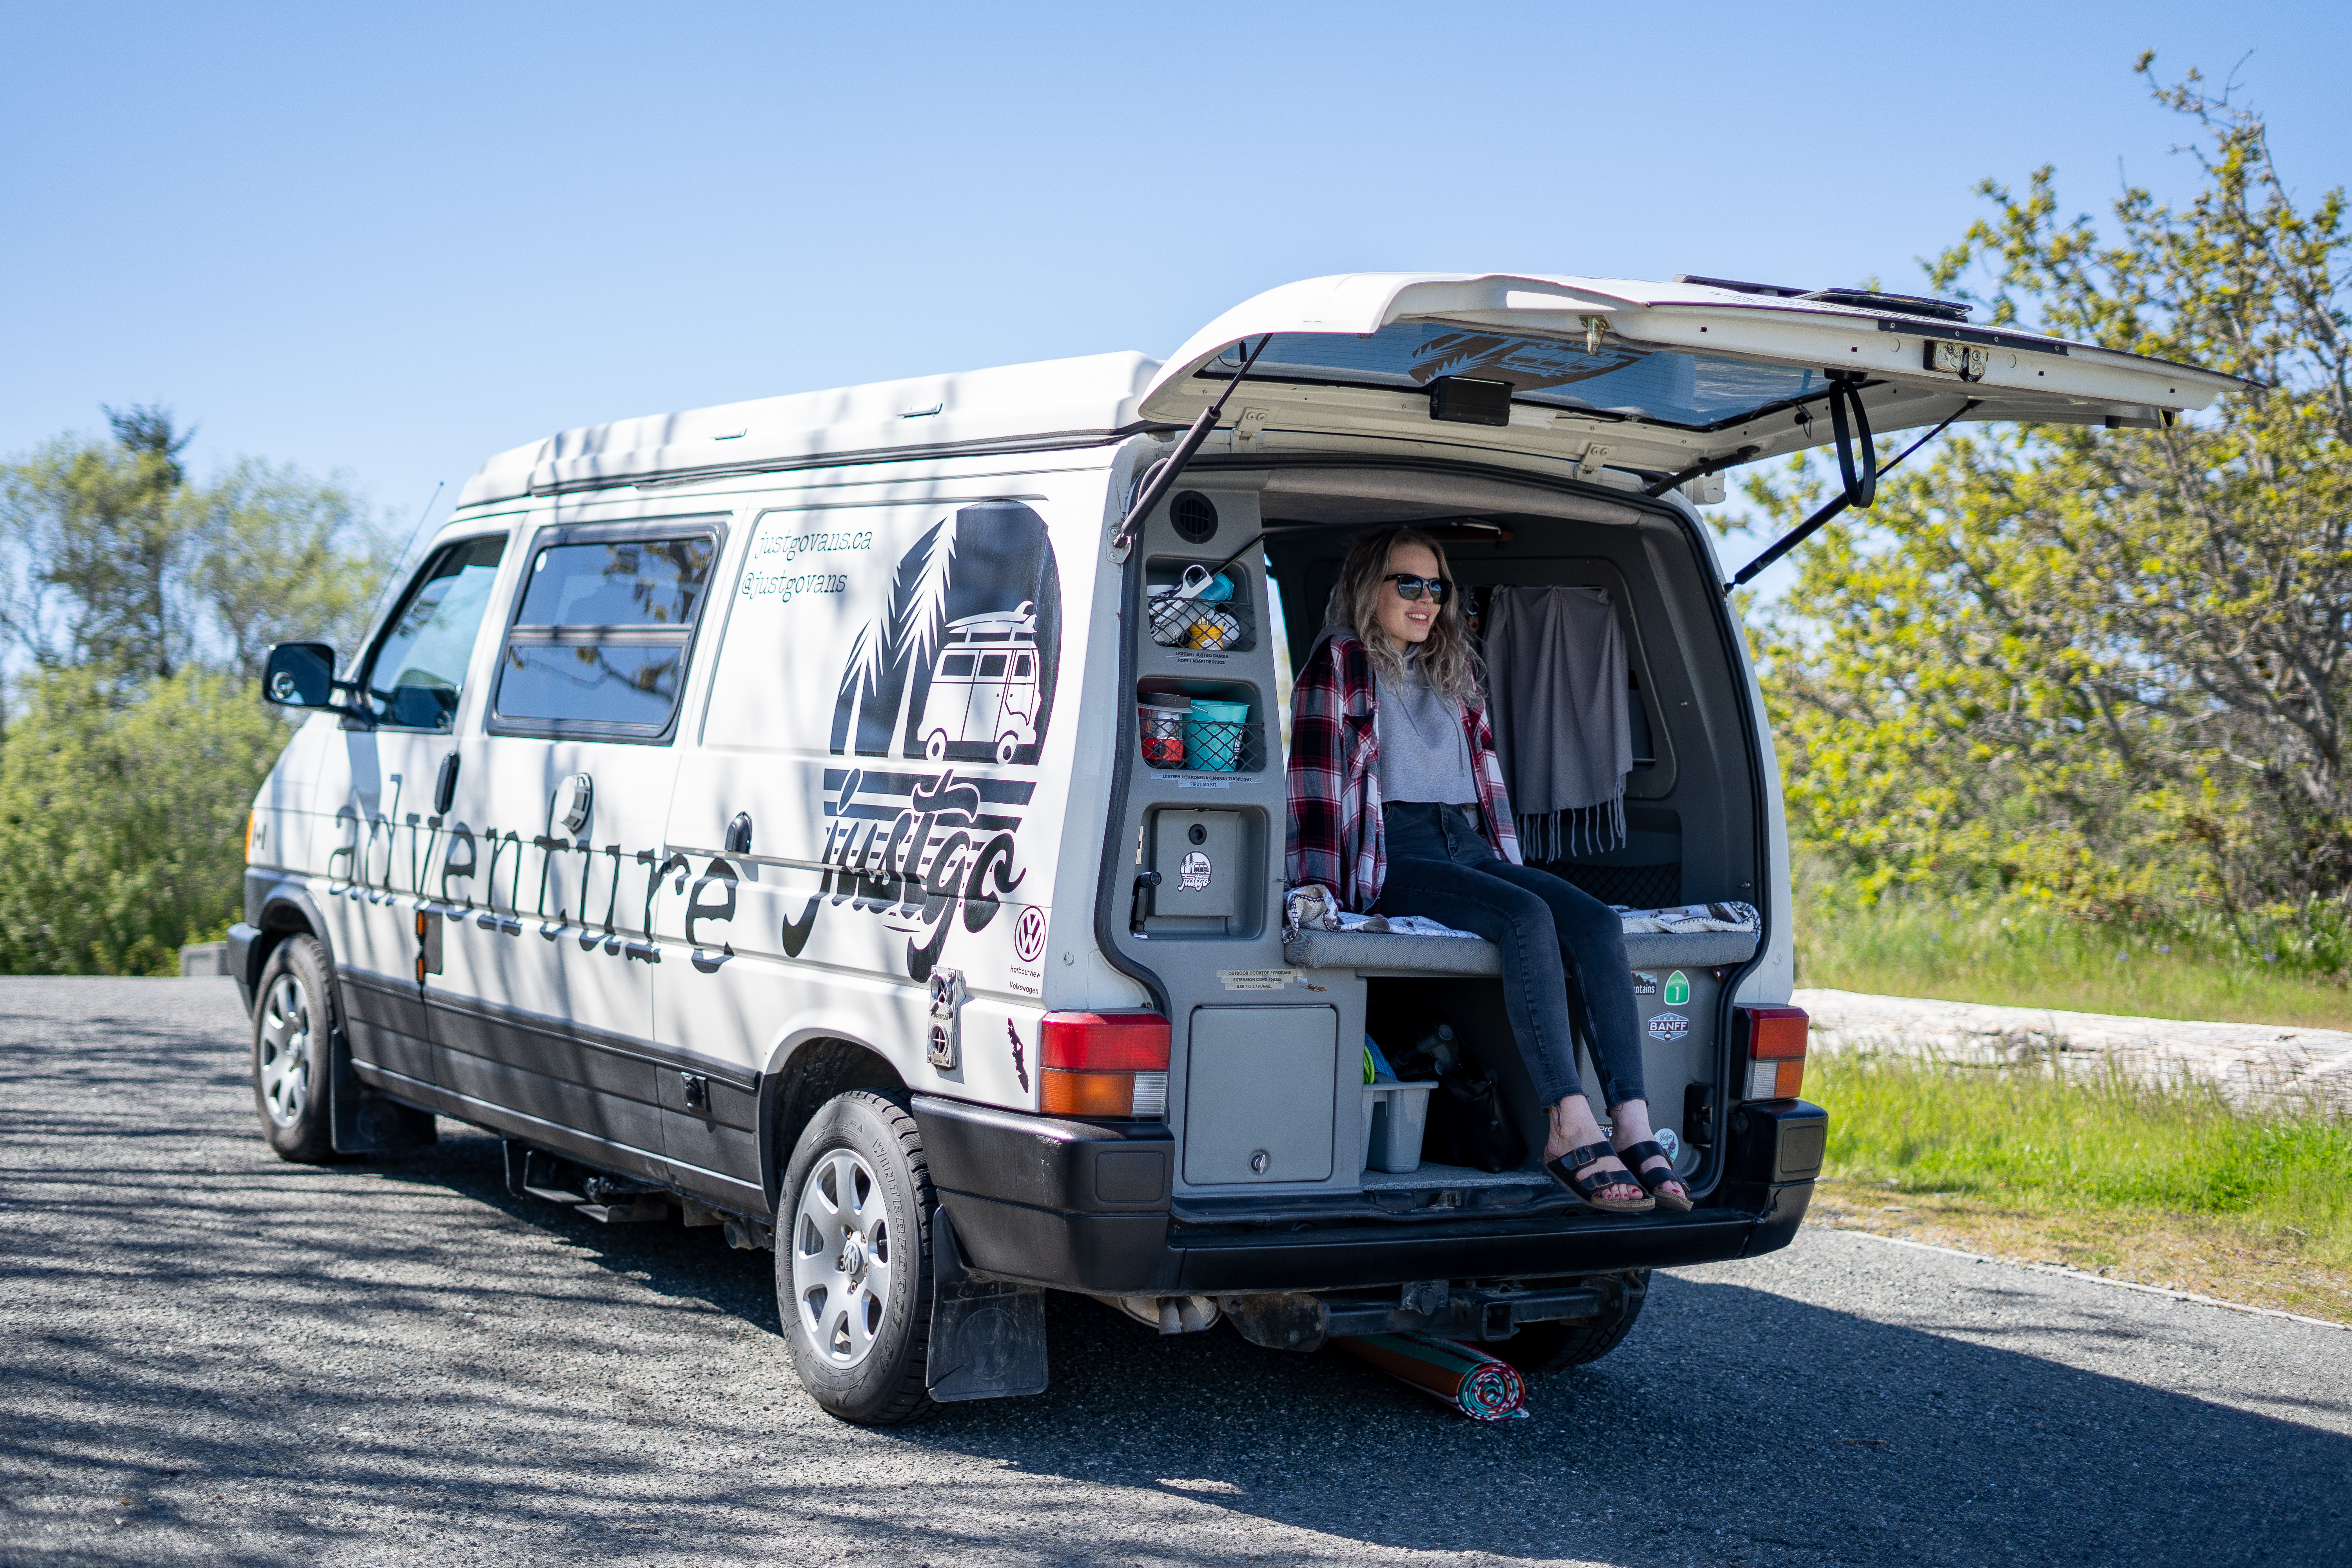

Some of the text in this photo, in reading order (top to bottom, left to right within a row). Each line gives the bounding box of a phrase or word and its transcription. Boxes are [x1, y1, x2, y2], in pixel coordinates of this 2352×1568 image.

[755, 530, 873, 561] justgovans.ca
[742, 572, 848, 602] @justgovans
[328, 773, 739, 973] adventure
[782, 768, 1026, 983] justgo
[1178, 874, 1210, 891] justgo
[1010, 965, 1041, 978] Harbourview
[1010, 981, 1039, 995] Volkswagen
[1634, 984, 1655, 993] ntains
[1675, 986, 1679, 1001] 1
[1650, 1022, 1687, 1031] BANFF
[873, 1138, 907, 1331] WINTERFORCE
